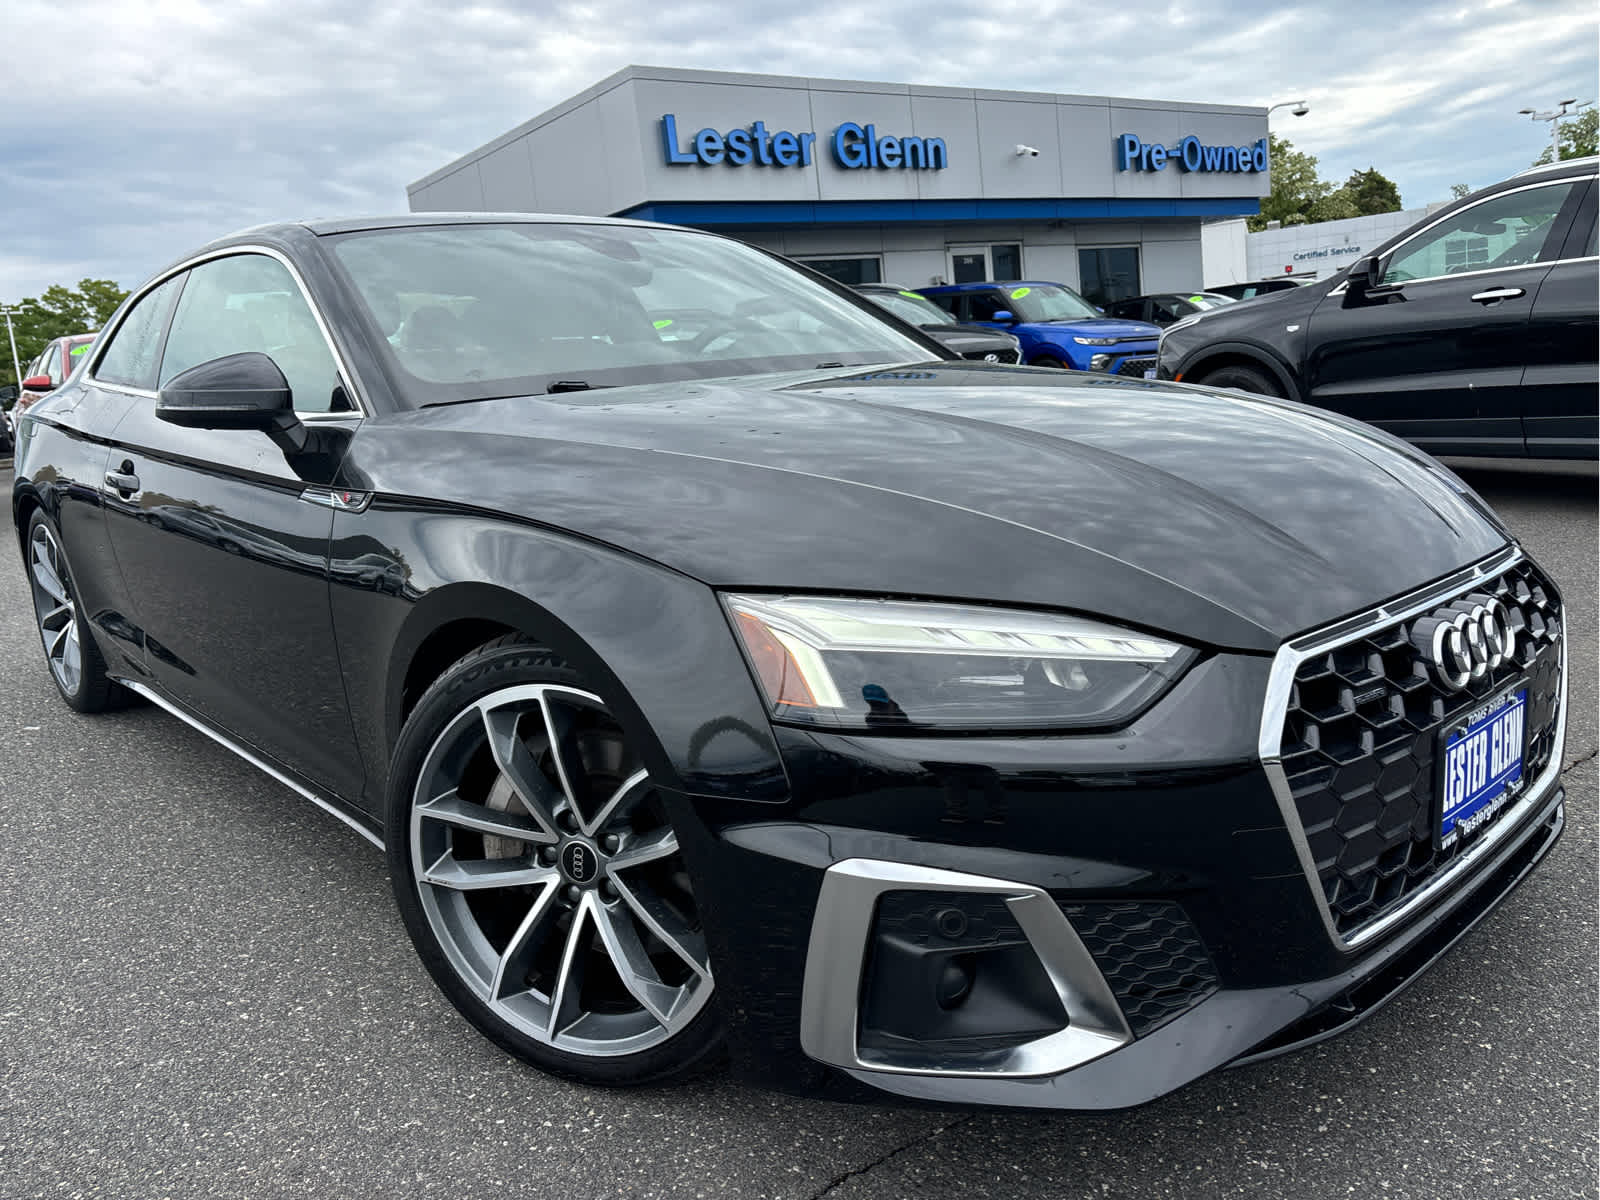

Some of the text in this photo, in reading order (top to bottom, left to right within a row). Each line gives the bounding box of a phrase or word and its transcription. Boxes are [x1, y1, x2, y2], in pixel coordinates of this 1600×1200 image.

[661, 113, 948, 169] Lester Glenn
[1118, 133, 1267, 172] Pre-Owned
[1293, 246, 1361, 261] Certified Service
[1468, 707, 1487, 727] TOMS
[1443, 703, 1524, 813] LESTER GLENN
